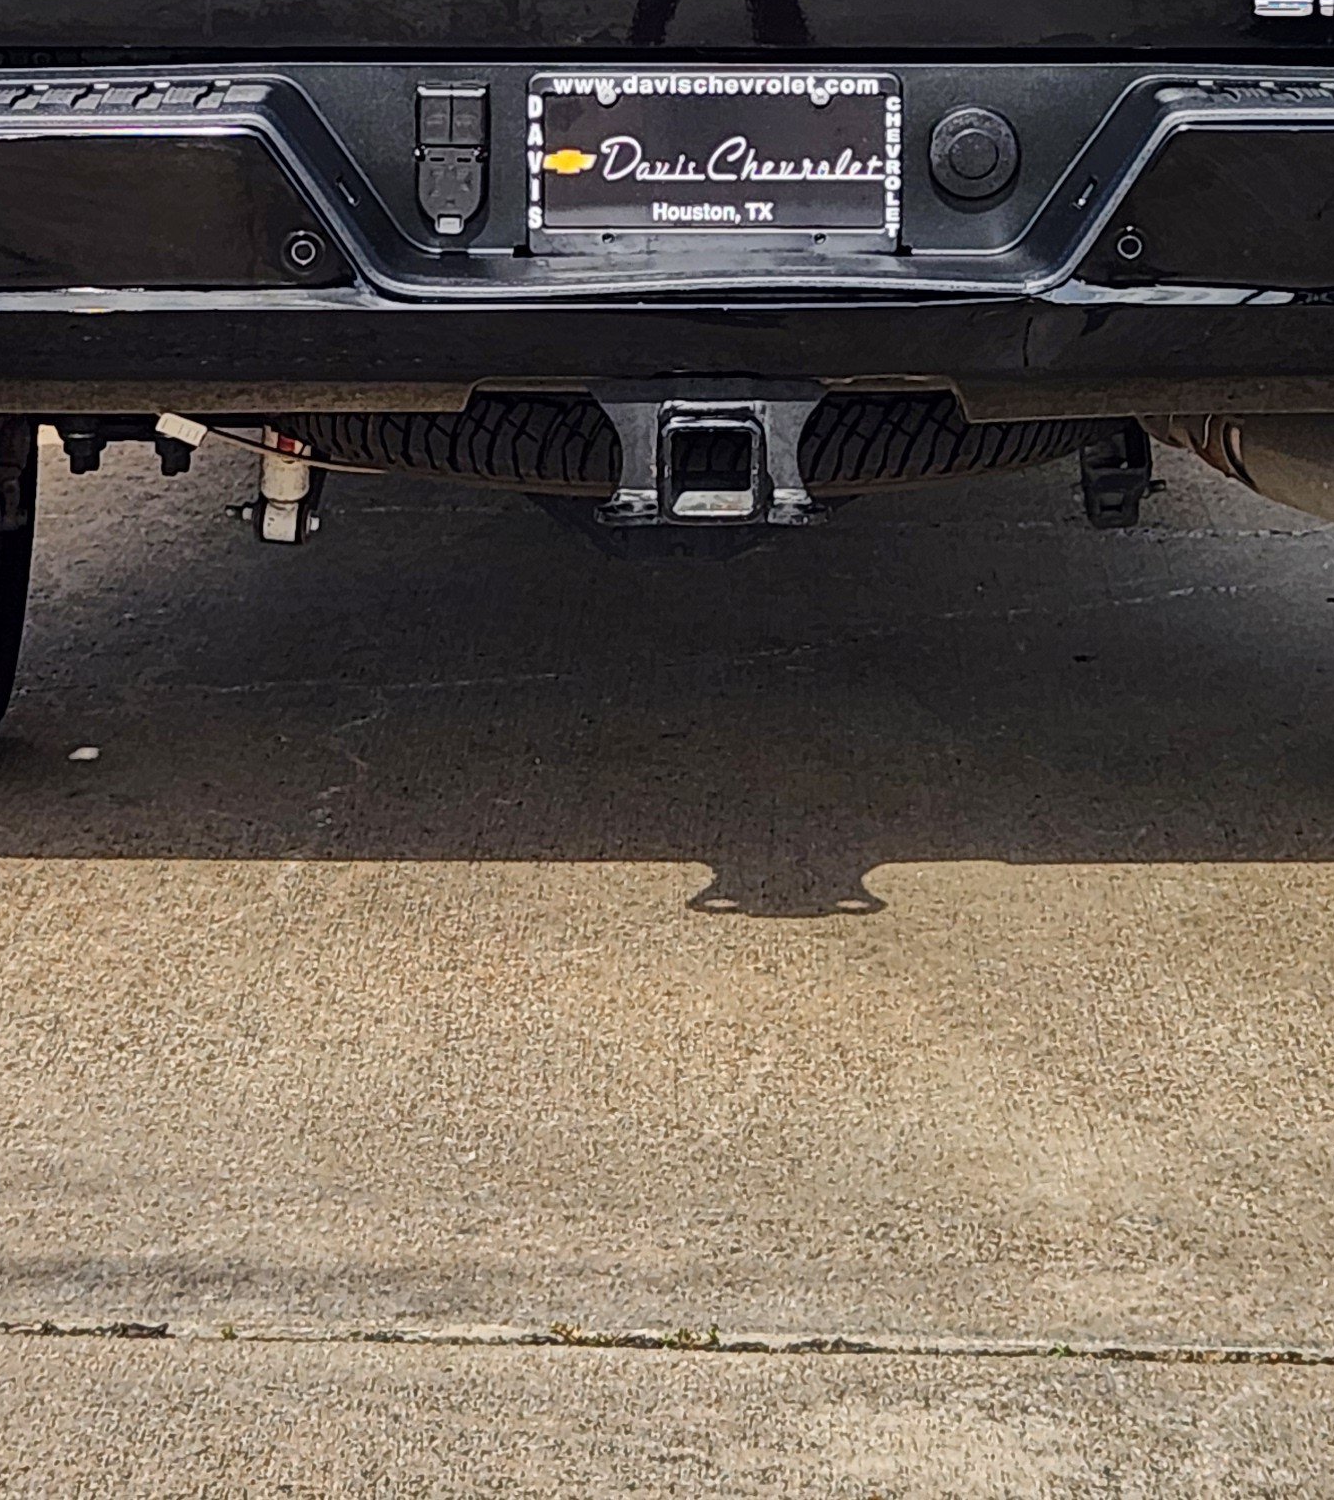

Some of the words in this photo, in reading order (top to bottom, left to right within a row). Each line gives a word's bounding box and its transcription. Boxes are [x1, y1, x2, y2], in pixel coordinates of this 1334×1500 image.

[527, 94, 544, 229] DAVIS
[600, 136, 706, 181] Davis
[707, 136, 884, 181] Chevrolet
[884, 96, 902, 238] CHEVROLET
[652, 202, 741, 224] Houston,
[744, 202, 774, 222] TX
